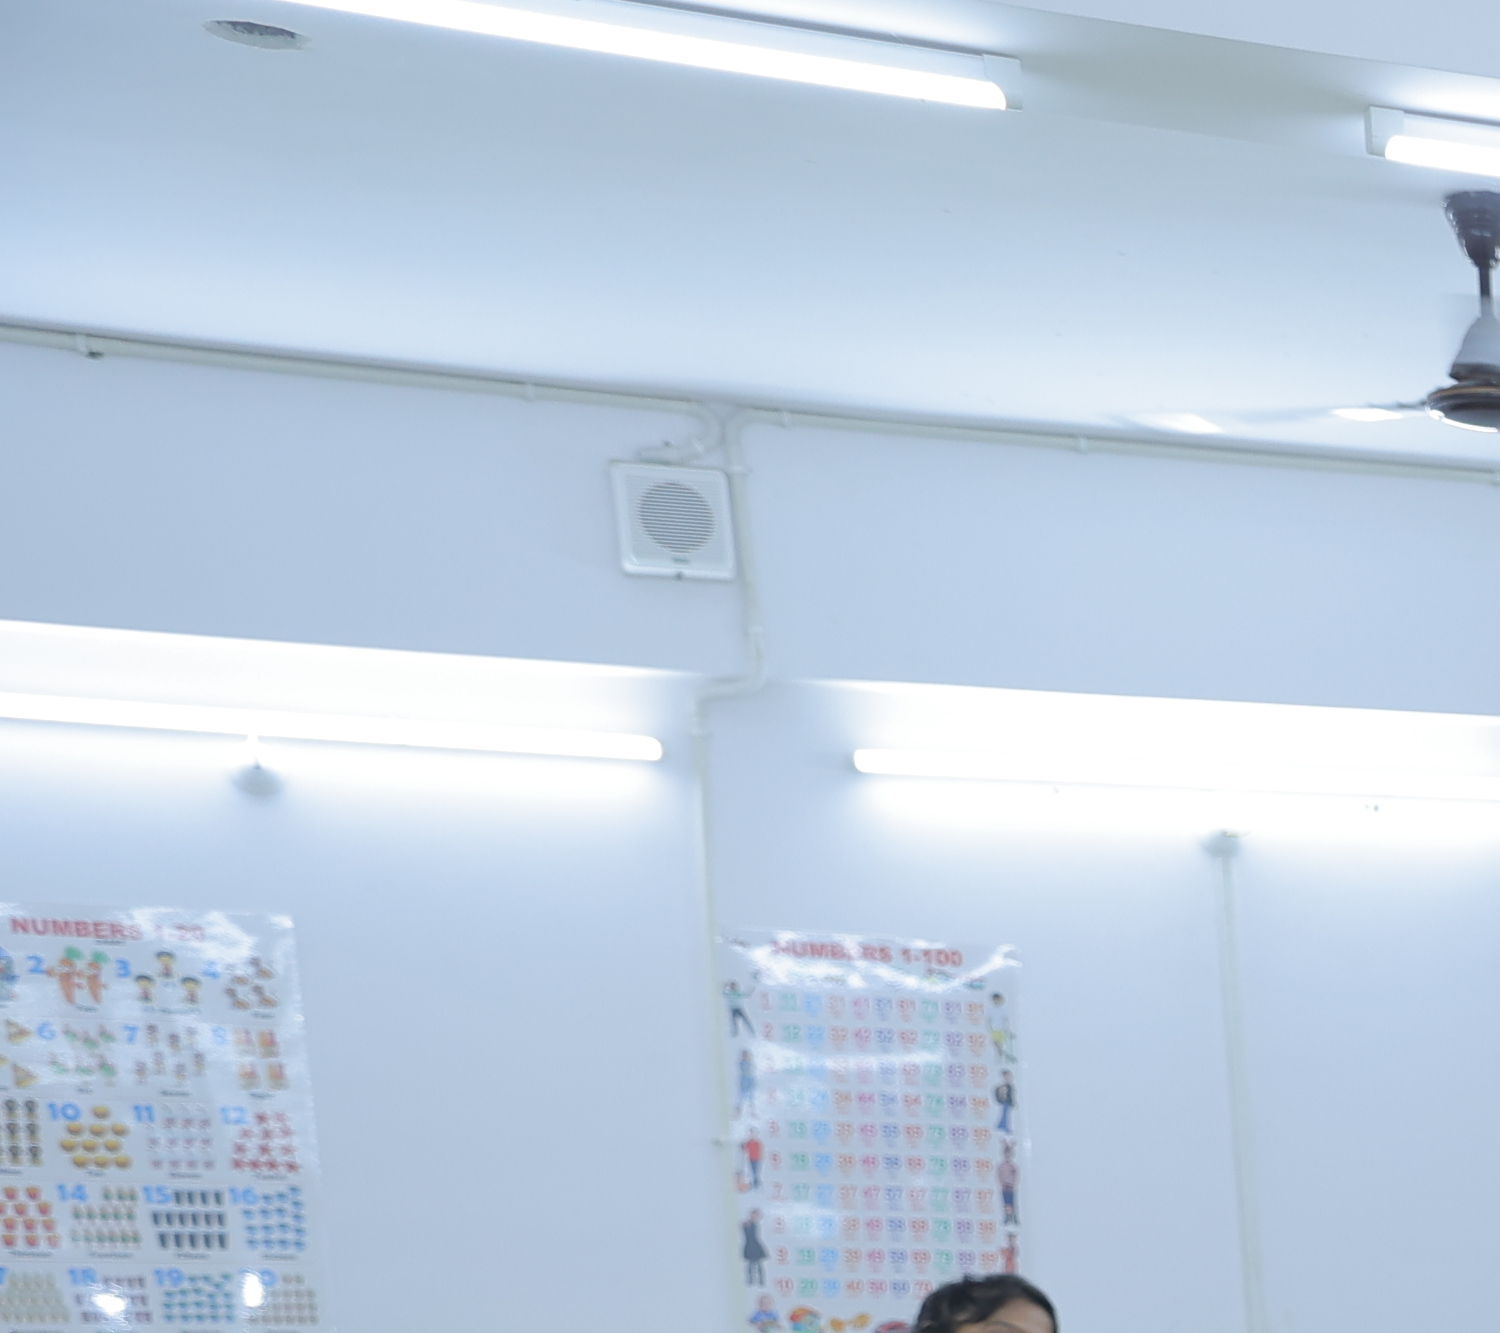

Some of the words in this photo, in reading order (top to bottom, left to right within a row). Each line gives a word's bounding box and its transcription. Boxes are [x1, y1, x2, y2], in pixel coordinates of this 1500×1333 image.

[10, 917, 143, 941] NUMBERS
[26, 955, 44, 974] 2
[901, 948, 963, 967] 1-100
[115, 959, 131, 978] 3
[37, 1022, 56, 1040] 6
[124, 1025, 139, 1043] 7
[48, 1103, 82, 1121] 10
[133, 1105, 155, 1122] 11
[57, 1184, 88, 1201] 14
[143, 1185, 171, 1204] 15
[229, 1186, 258, 1205] 16
[68, 1267, 97, 1287] 18
[153, 1268, 186, 1288] 19
